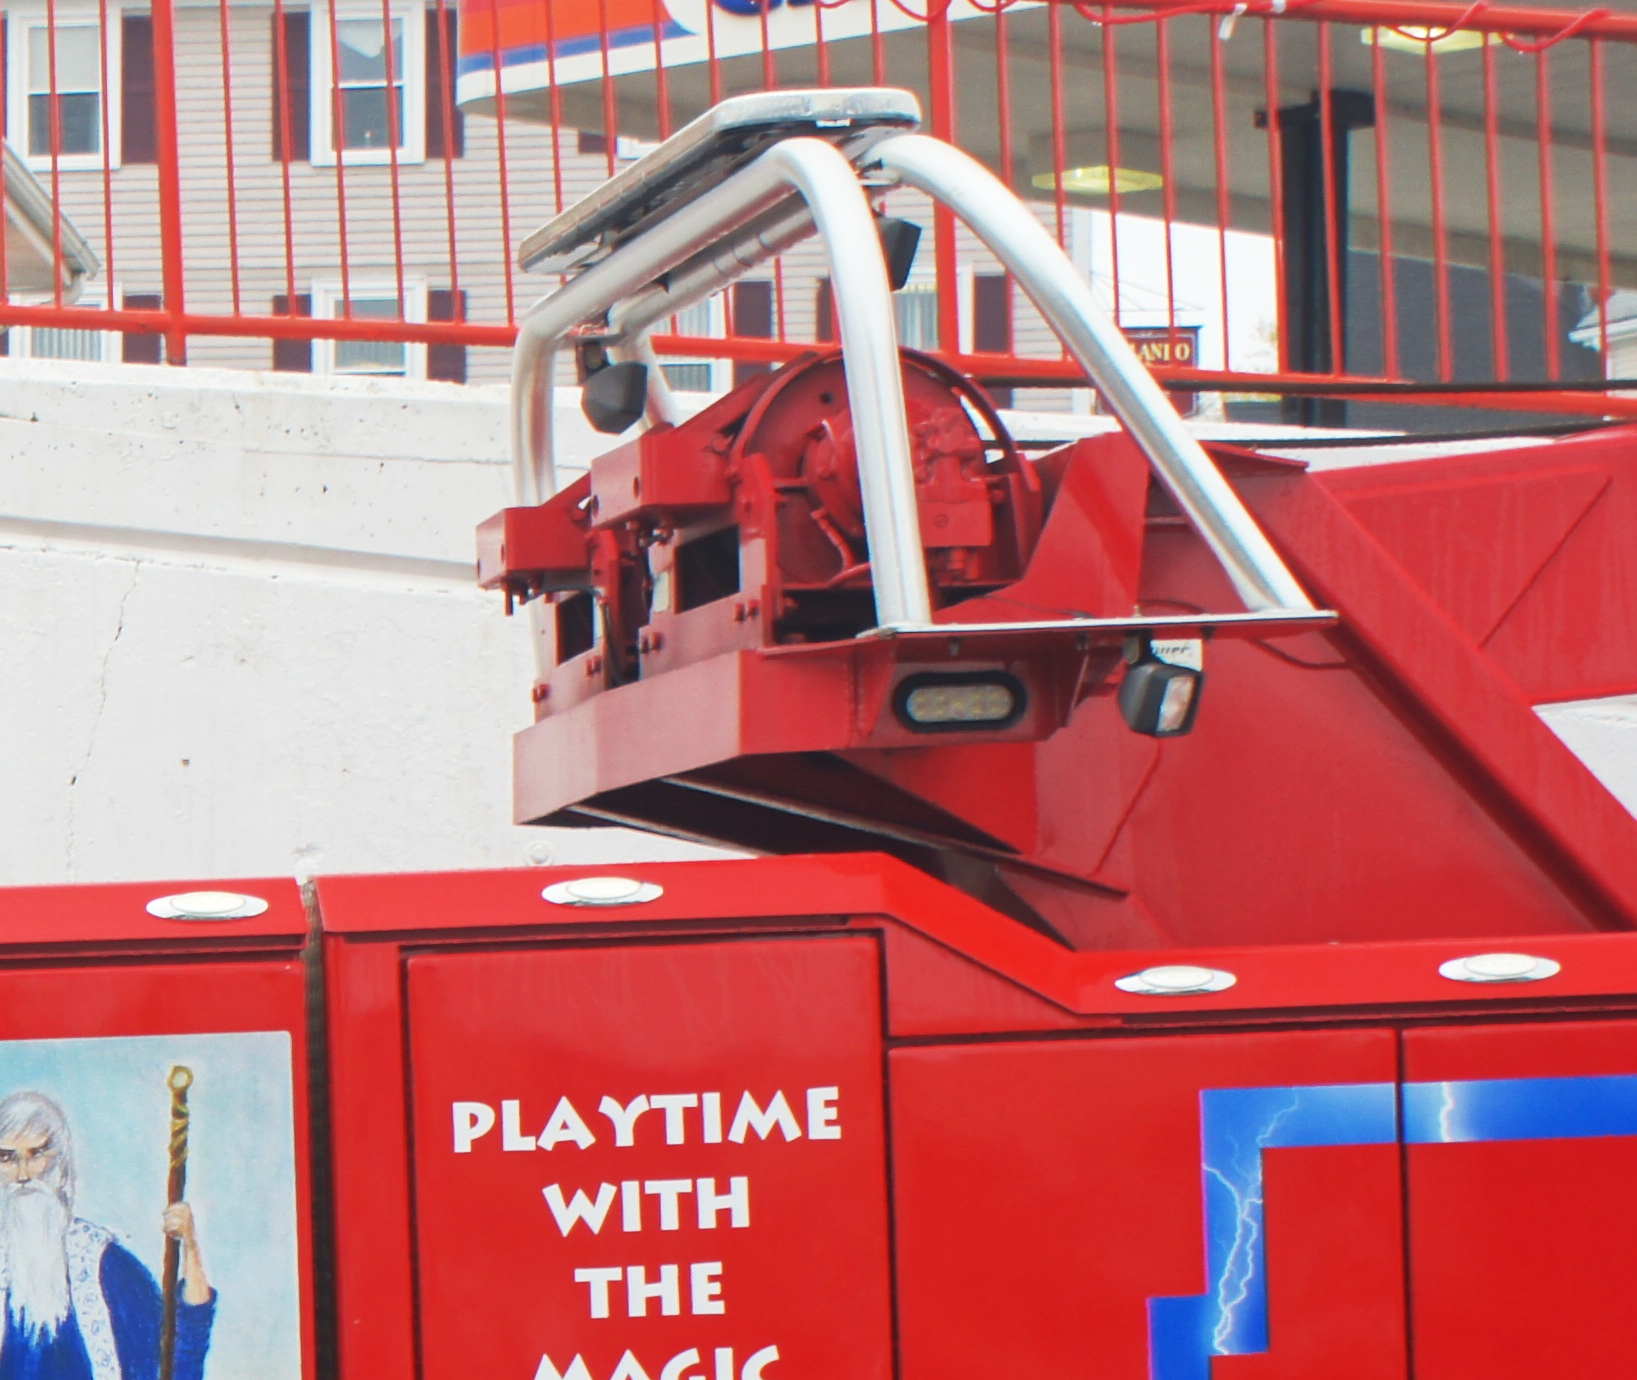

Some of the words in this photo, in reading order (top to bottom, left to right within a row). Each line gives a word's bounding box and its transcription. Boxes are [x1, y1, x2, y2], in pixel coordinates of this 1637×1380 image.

[452, 1086, 842, 1153] PLAYTIME
[541, 1176, 750, 1237] WITH
[574, 1261, 725, 1319] THE
